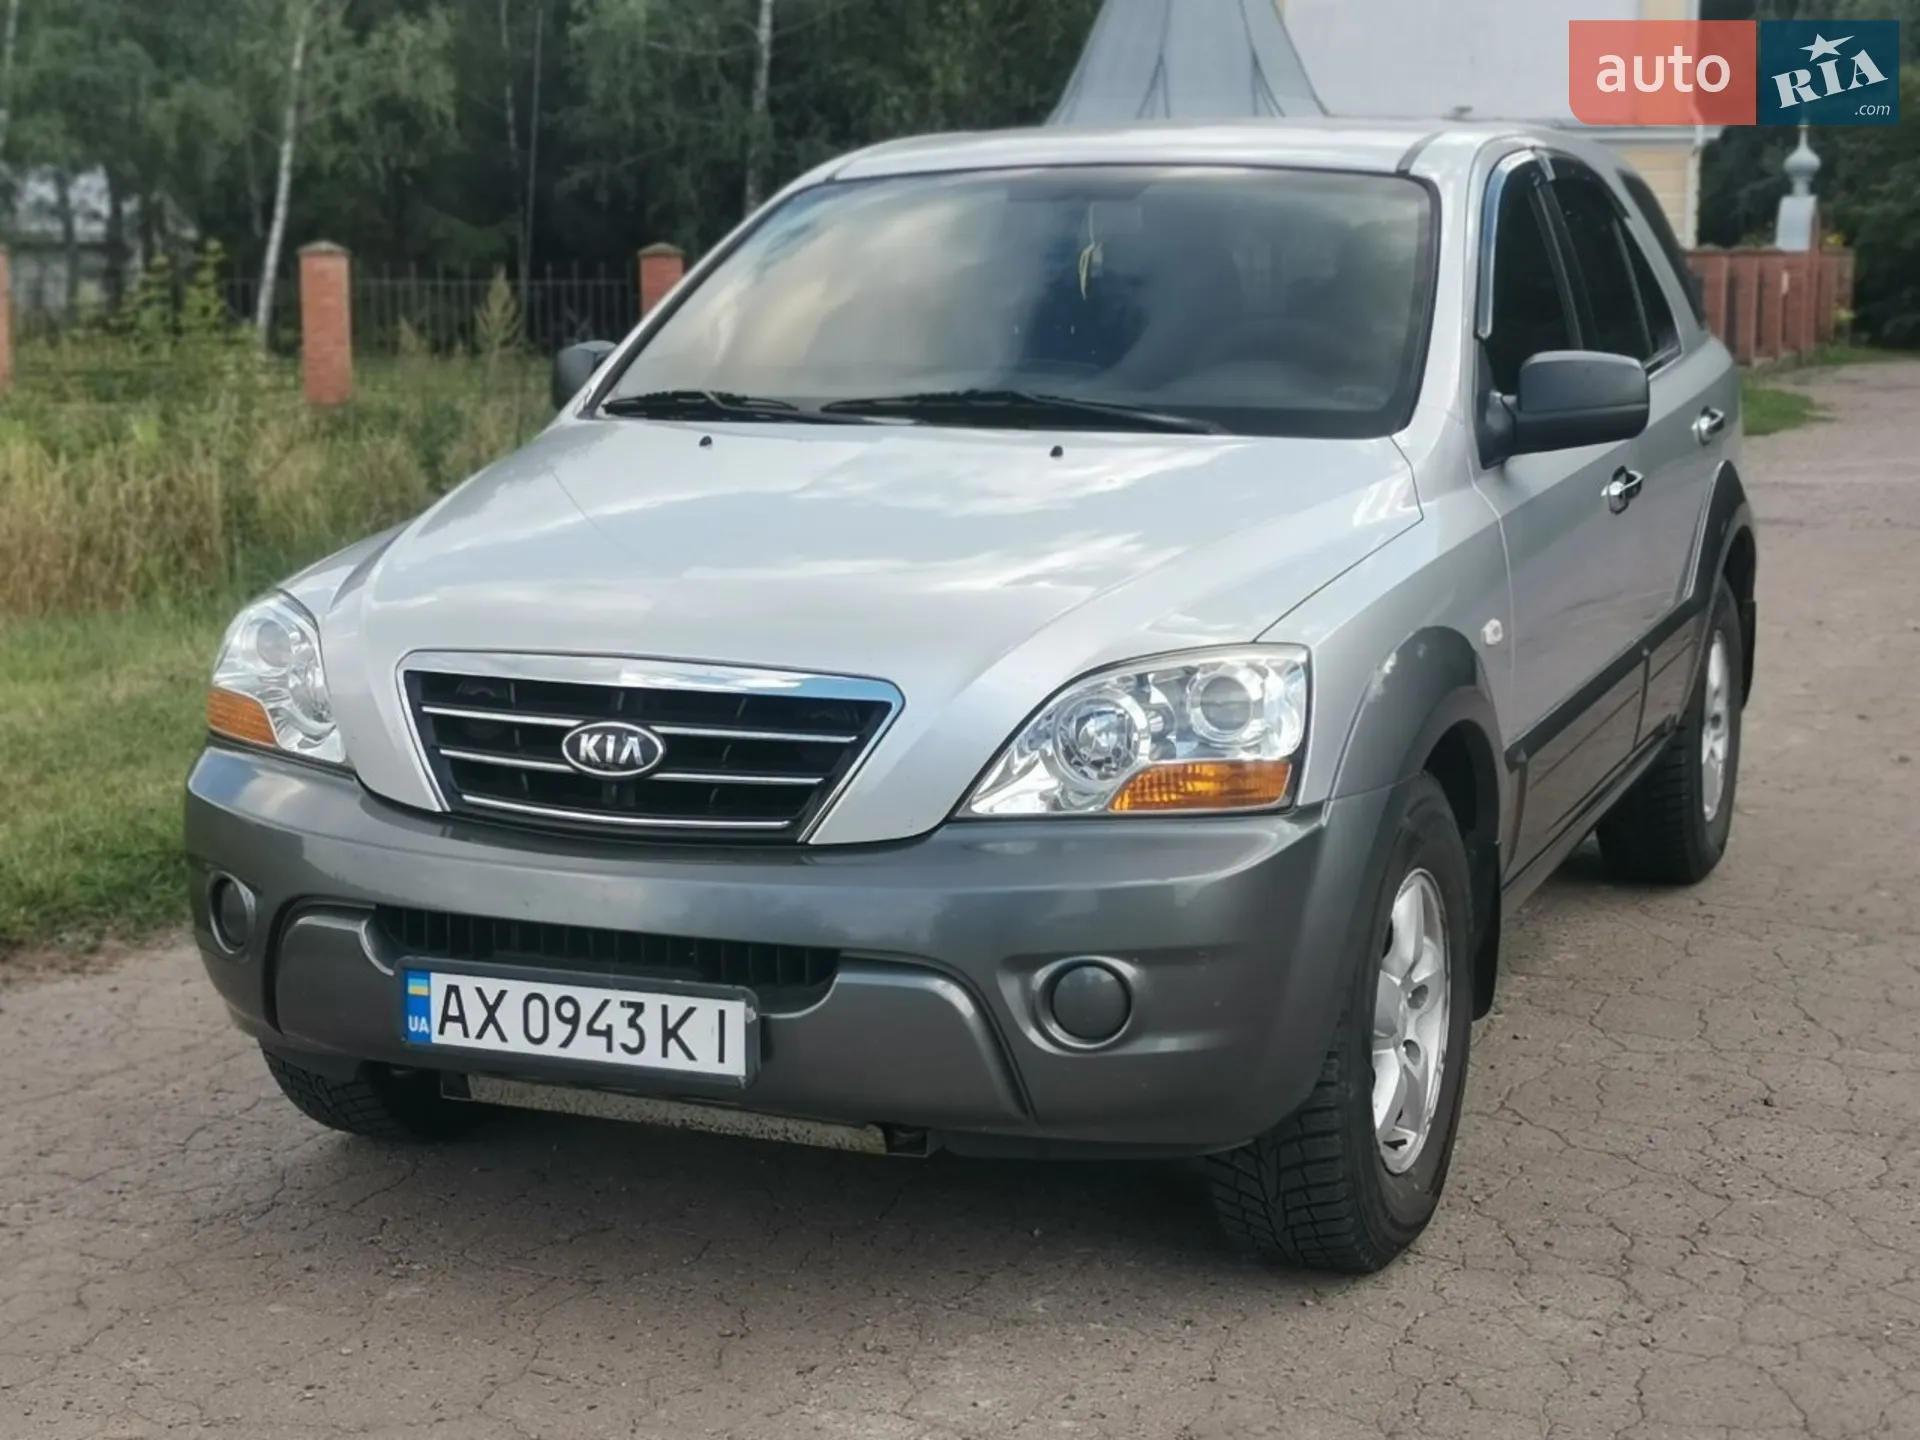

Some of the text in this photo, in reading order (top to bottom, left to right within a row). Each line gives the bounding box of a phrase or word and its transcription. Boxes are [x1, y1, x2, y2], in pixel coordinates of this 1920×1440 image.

[579, 733, 644, 765] KIA
[408, 1015, 430, 1033] UA
[438, 984, 508, 1043] AX
[522, 992, 646, 1056] 0943
